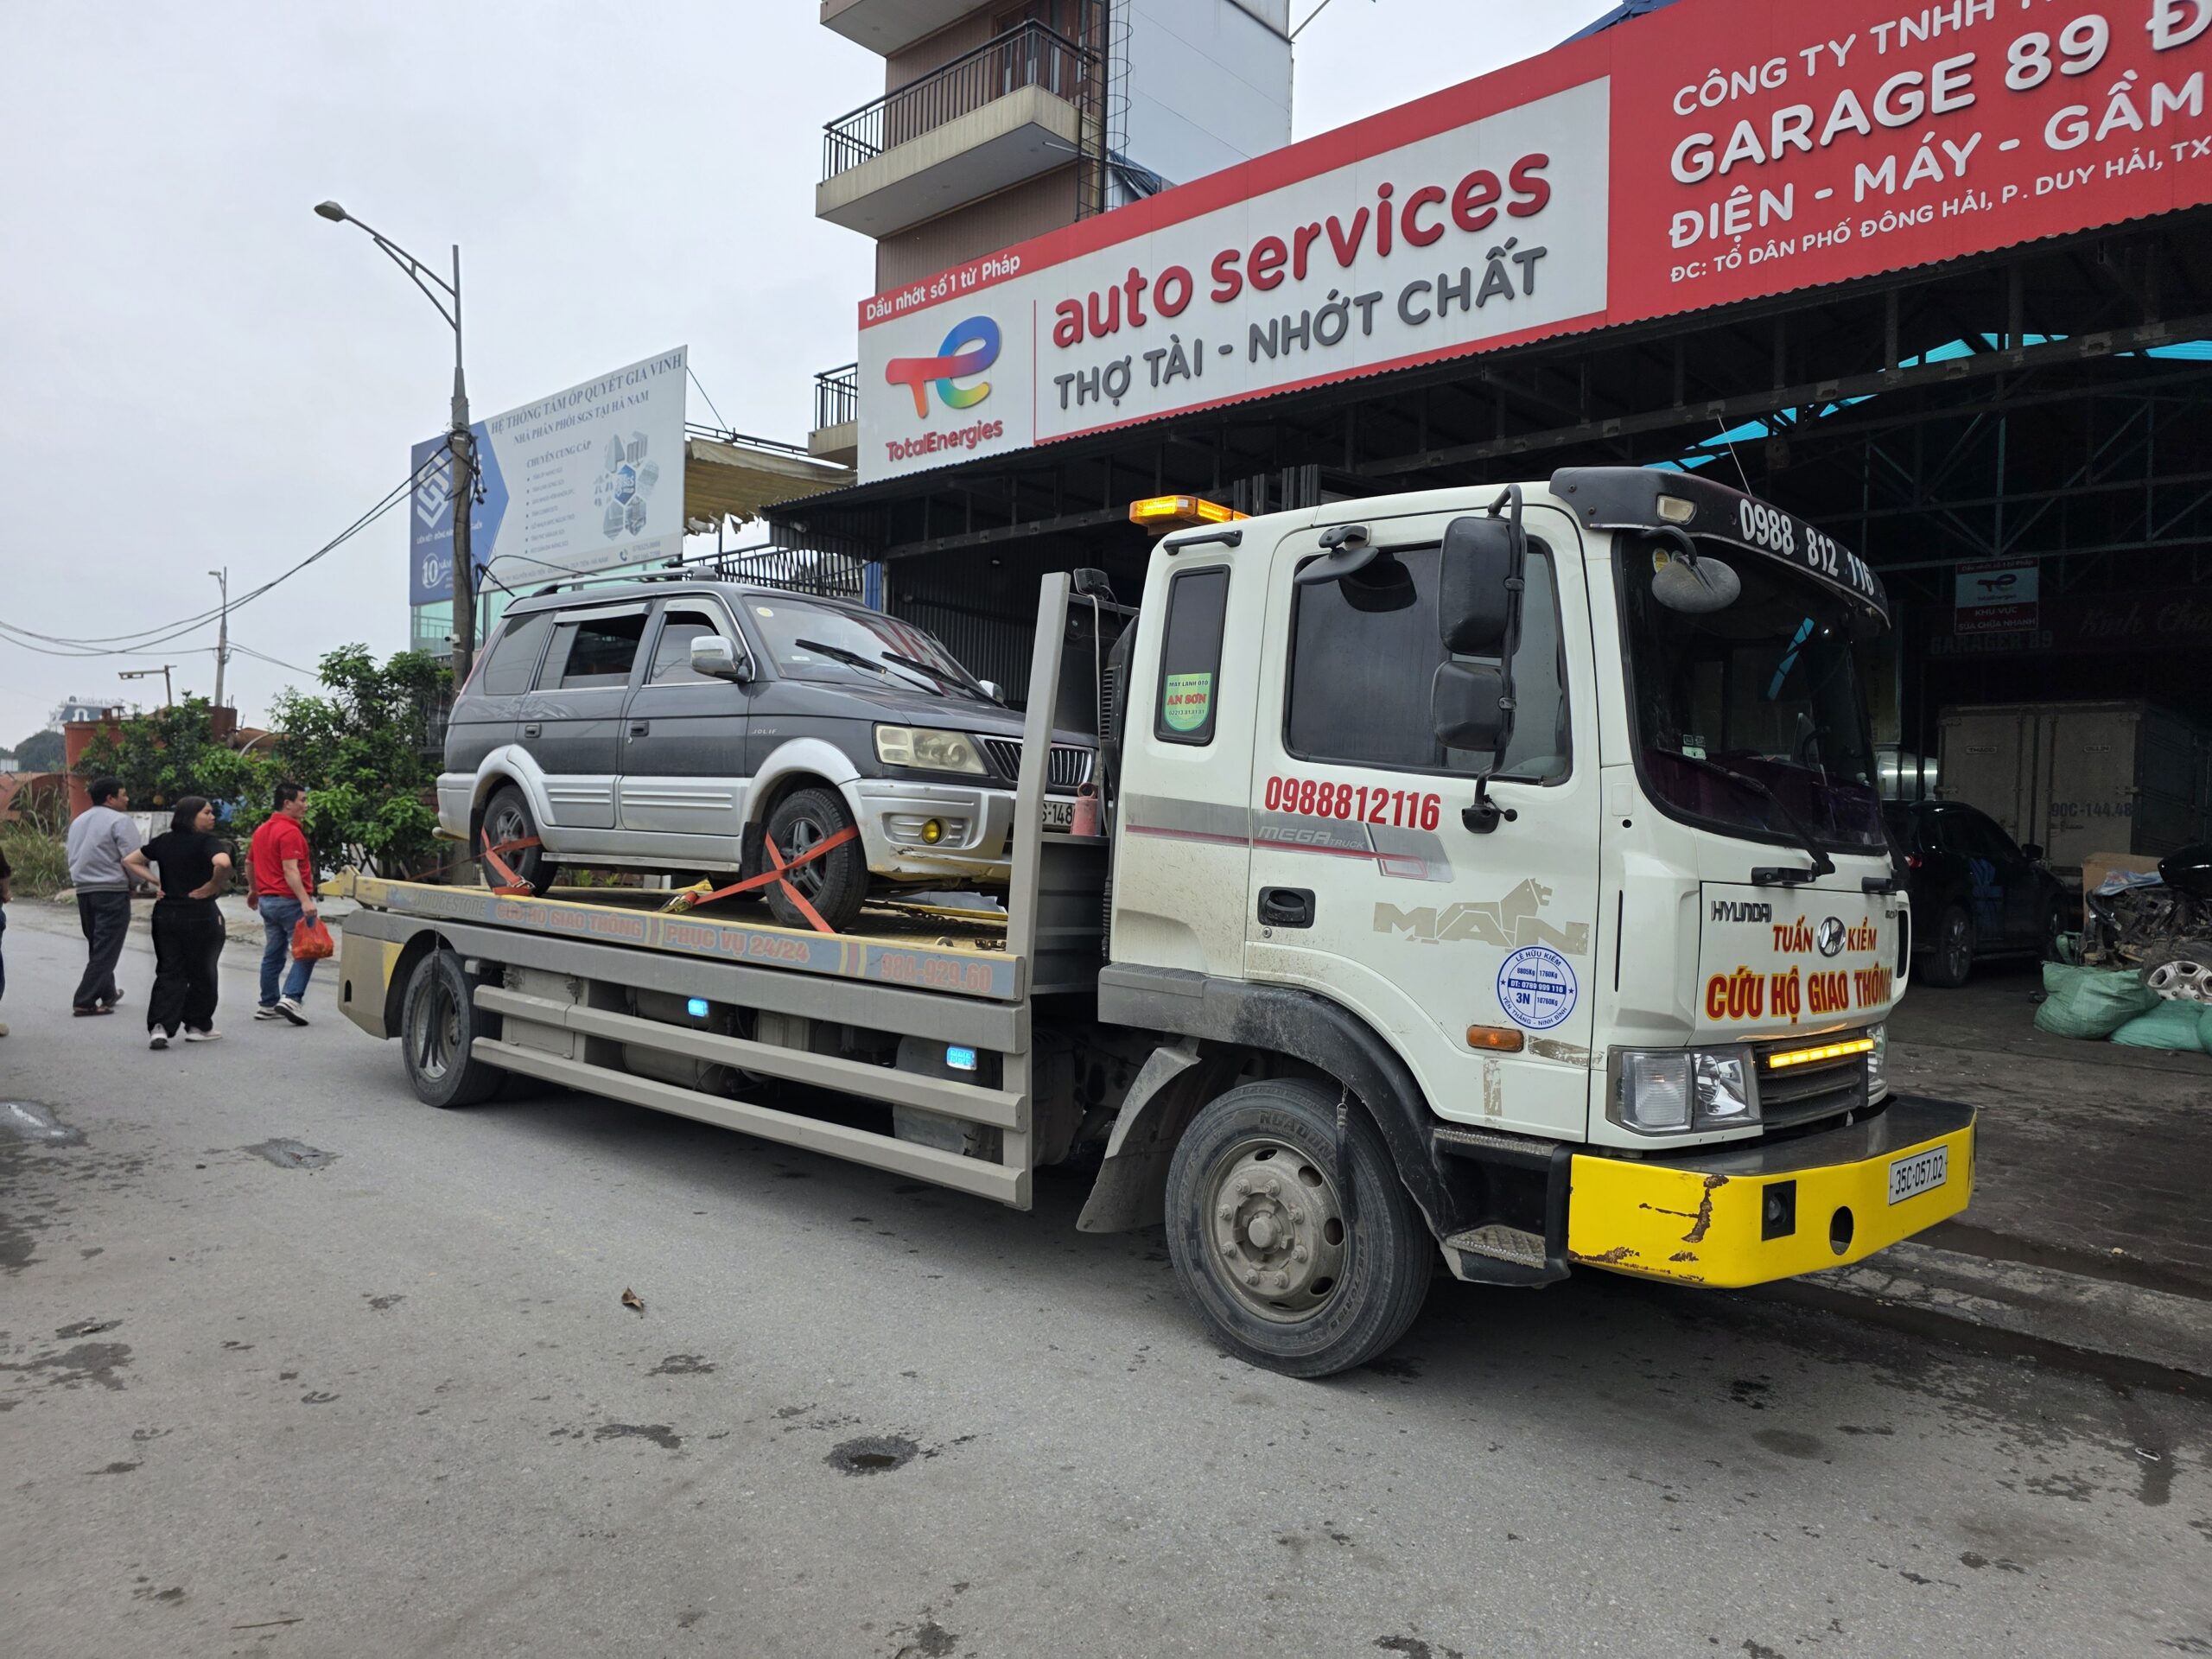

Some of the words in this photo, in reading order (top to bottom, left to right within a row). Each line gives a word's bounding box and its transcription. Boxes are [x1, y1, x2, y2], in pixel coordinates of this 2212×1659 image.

[1674, 57, 1787, 116] CÔNG
[1800, 34, 1856, 77] TY
[1870, 0, 1994, 54] TNHH
[1670, 53, 1977, 183] GARAGE
[2005, 14, 2109, 90] 89
[1669, 183, 1794, 249] ĐIỆN
[1853, 131, 1982, 203] MÁY
[2044, 69, 2203, 150] GẦM
[1670, 259, 1707, 282] ĐC:
[1713, 238, 1743, 271] TỔ
[1749, 239, 1796, 265] DÂN
[1802, 217, 1852, 252] PHỐ
[1859, 207, 1934, 238] ĐÔNG
[1942, 187, 1993, 216] HẢI,
[2036, 164, 2095, 197] DUY
[2105, 147, 2163, 175] HẢI,
[1052, 264, 1193, 347] auto
[1209, 152, 1552, 303] services
[867, 296, 892, 321] Dầu
[895, 286, 926, 311] nhớt
[930, 274, 949, 298] số
[950, 275, 957, 292] 1
[961, 268, 977, 288] từ
[982, 254, 1020, 281] Pháp
[1054, 357, 1130, 406] THỢ
[1142, 333, 1203, 388] TÀI
[1248, 289, 1382, 363] NHỚT
[1397, 236, 1547, 325] CHẤT
[626, 366, 648, 386] GIA
[650, 353, 682, 376] VINH
[626, 390, 650, 407] NAM
[886, 420, 1004, 462] TotalEnergies
[1739, 498, 1795, 556] 0988
[1805, 527, 1839, 577] 812
[1847, 551, 1874, 596] 116
[1167, 695, 1183, 705] AN
[1264, 776, 1442, 831] 0988812116
[1258, 826, 1332, 844] MEGA
[1330, 839, 1365, 849] TRUCK
[1711, 900, 1772, 922] HYUNDAI
[1773, 914, 1814, 952] TUẤN
[550, 909, 585, 930] GIAO
[588, 913, 644, 938] THÔNG
[665, 925, 715, 950] PHỤC
[720, 930, 747, 957] VỤ
[749, 935, 810, 963] 24/24
[1516, 952, 1524, 962] LÊ
[1516, 992, 1530, 1004] 3N
[1554, 1007, 1567, 1020] BÌNH
[1707, 963, 1765, 1021] CỨU
[1770, 965, 1801, 1025] HỘ
[1808, 969, 1850, 1015] GIAO
[1853, 961, 1893, 1009] THÔNG
[1896, 1154, 1943, 1194] 35C-057.02
